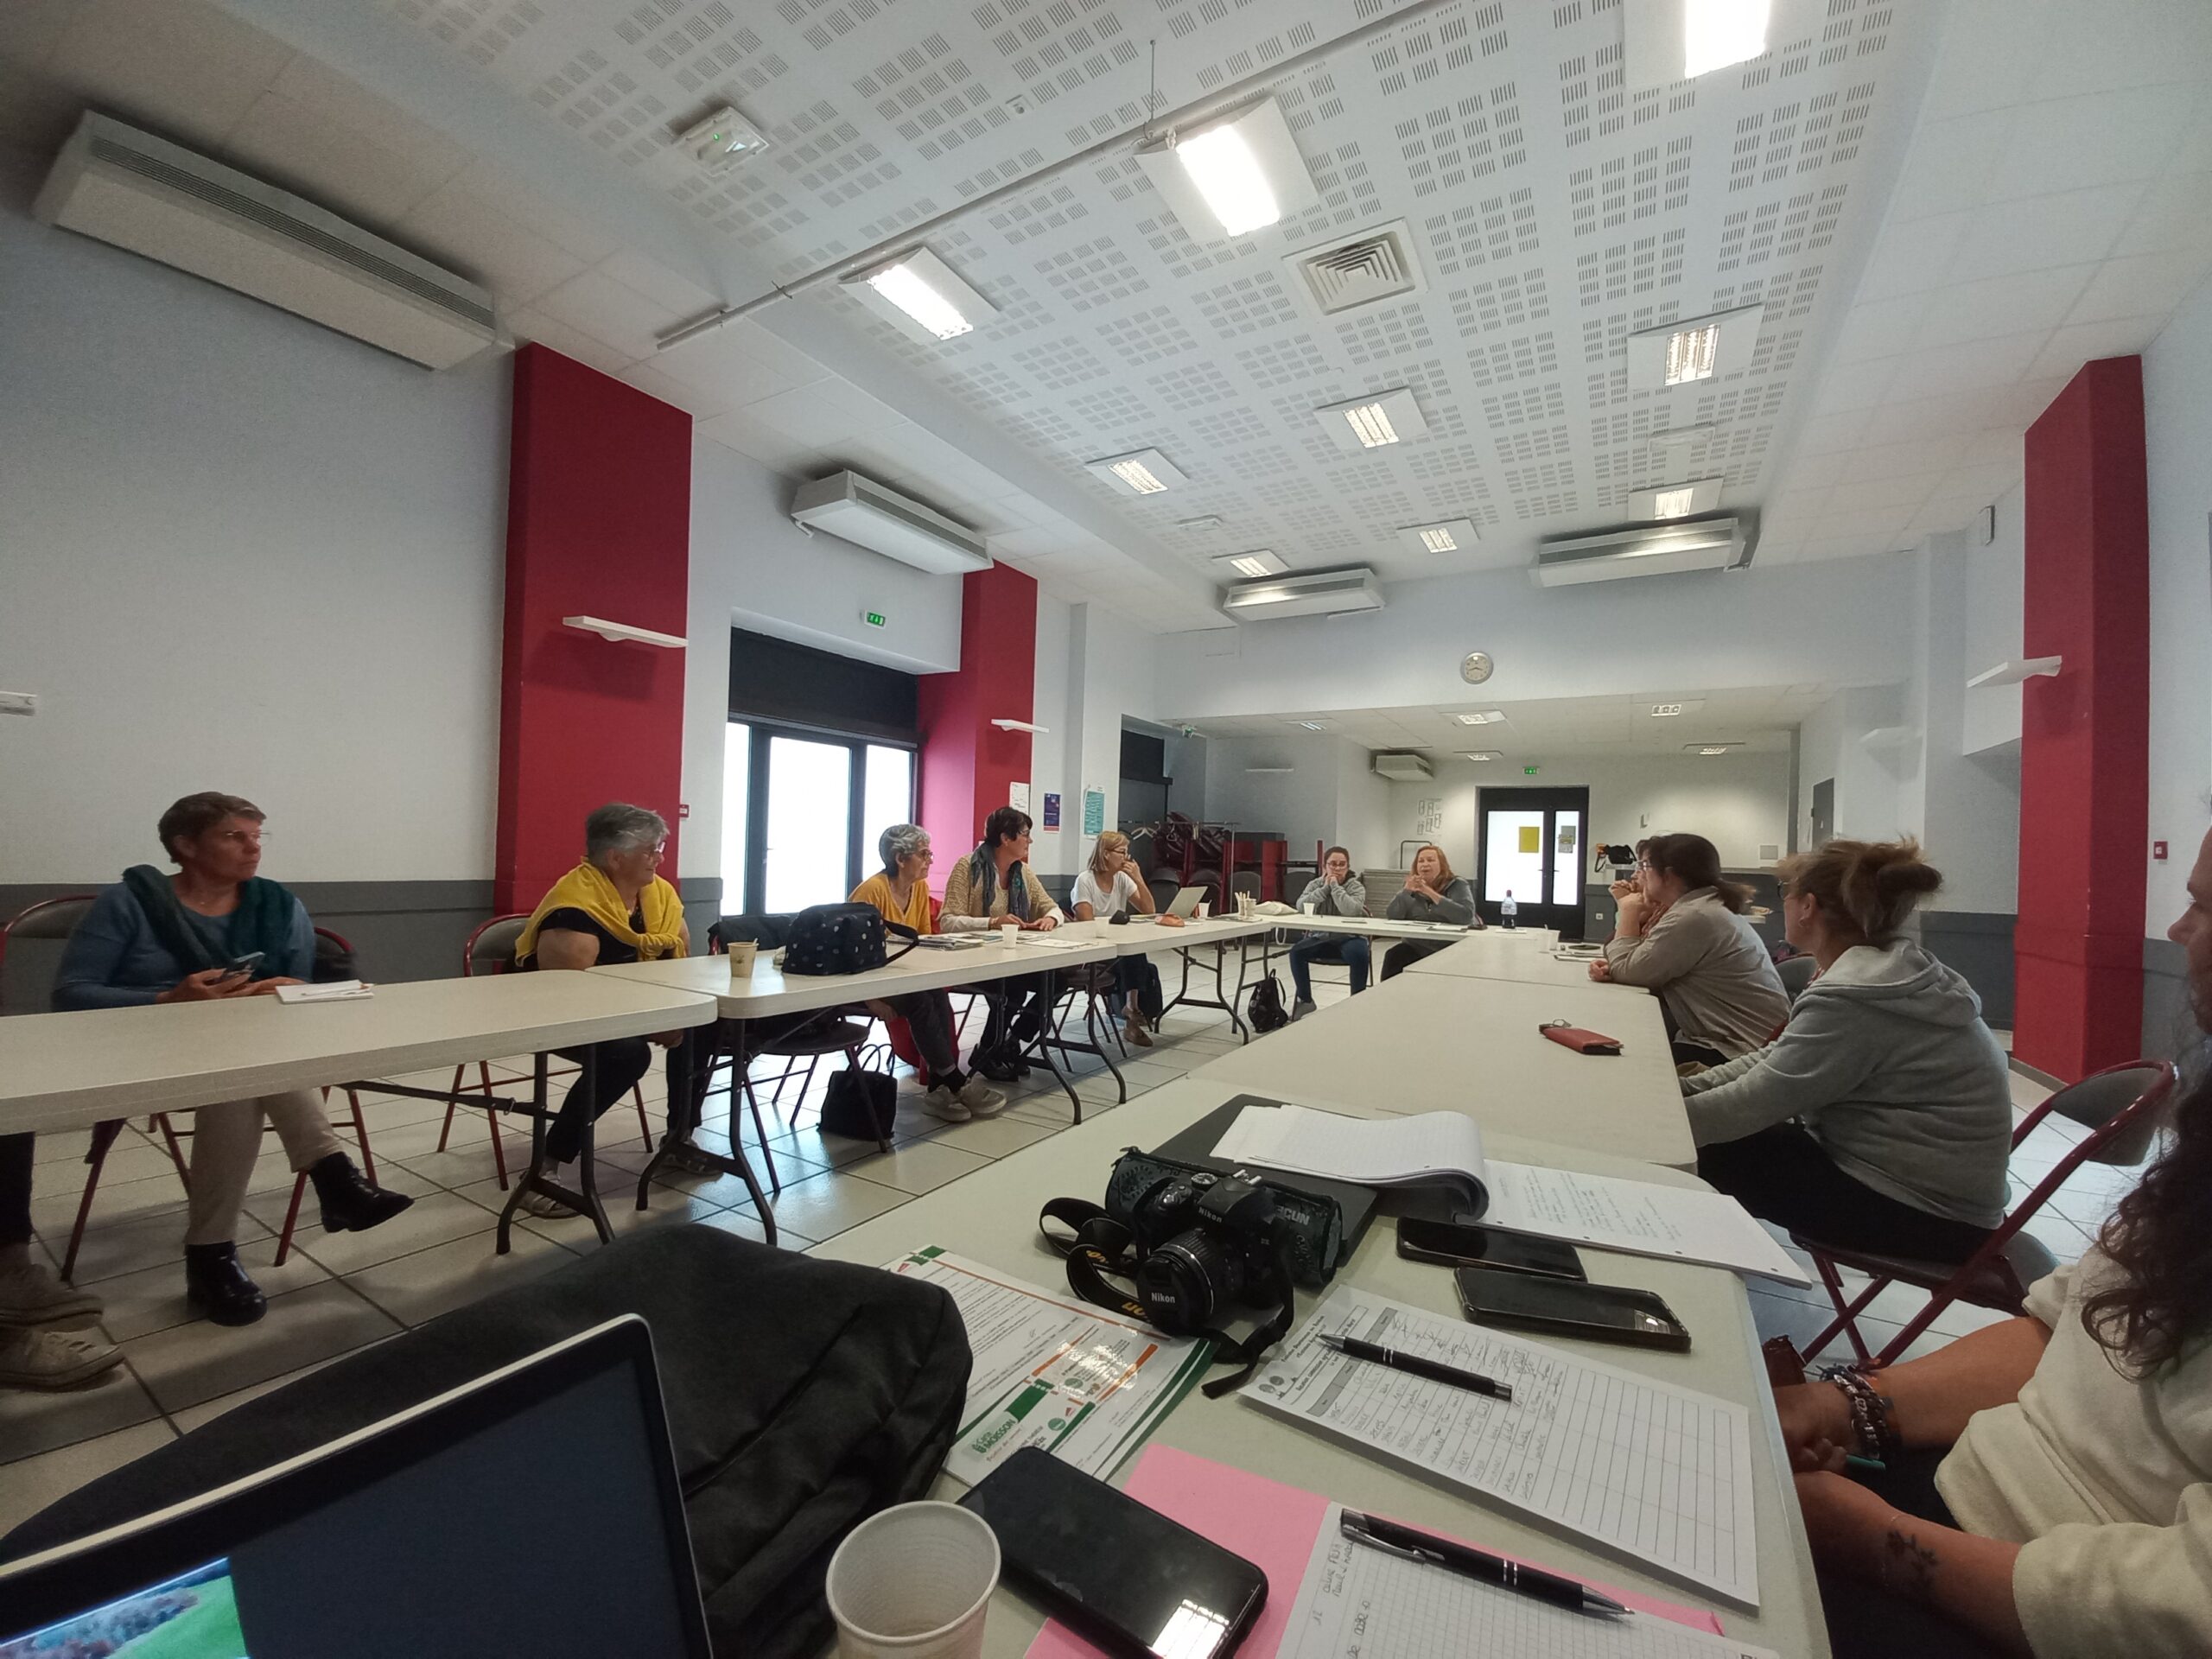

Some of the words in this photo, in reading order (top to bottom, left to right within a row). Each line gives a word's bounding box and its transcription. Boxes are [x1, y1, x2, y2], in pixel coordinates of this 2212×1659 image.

[1198, 1206, 1223, 1224] Nikon
[1151, 1292, 1176, 1305] Nikon
[983, 1418, 1016, 1449] MOISSON
